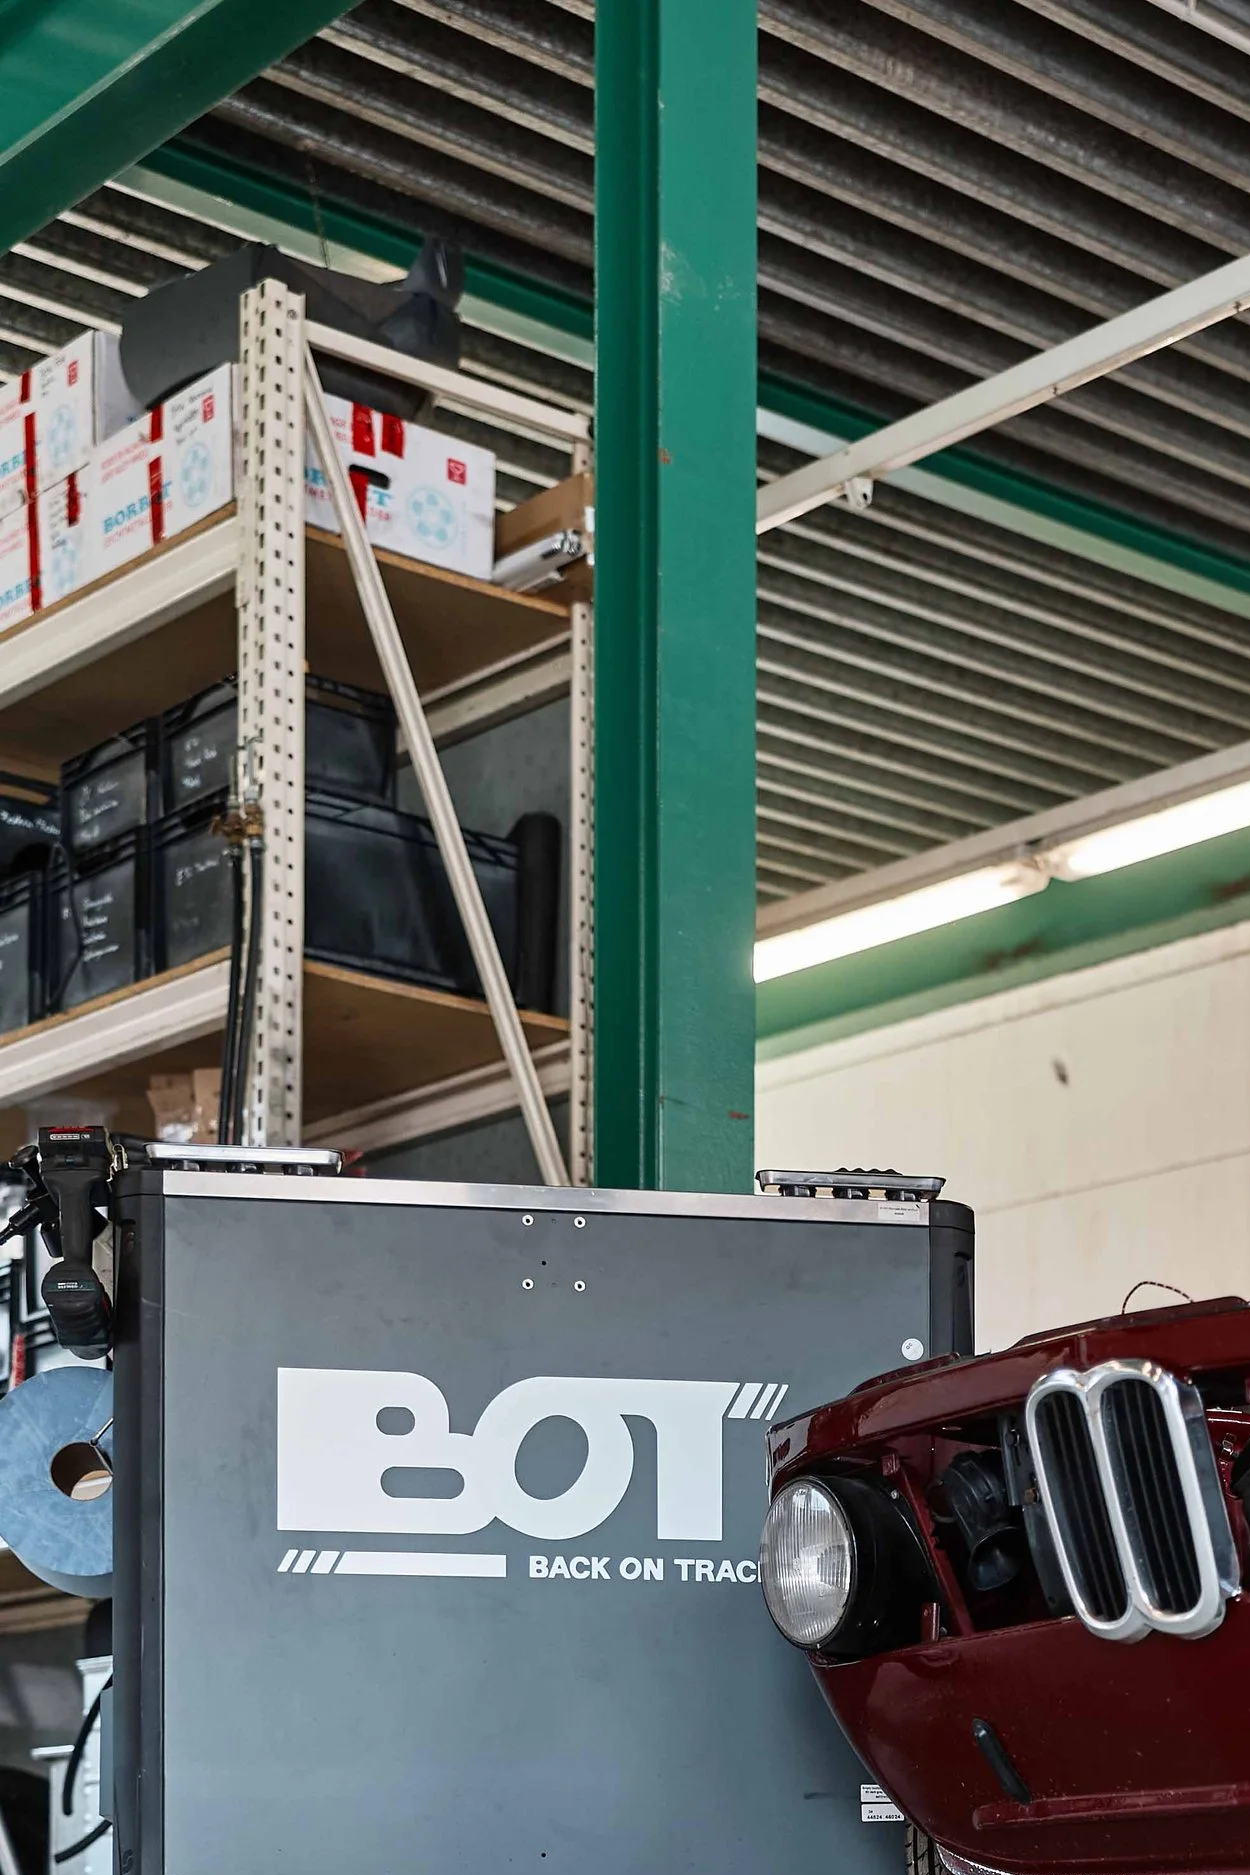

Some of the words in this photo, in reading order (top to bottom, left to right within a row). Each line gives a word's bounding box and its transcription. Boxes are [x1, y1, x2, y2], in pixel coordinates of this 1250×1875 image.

[103, 480, 172, 535] BORBT
[277, 1367, 741, 1542] BOT
[529, 1555, 611, 1580] BACK
[618, 1556, 664, 1581] ON
[673, 1558, 764, 1584] TRAC
